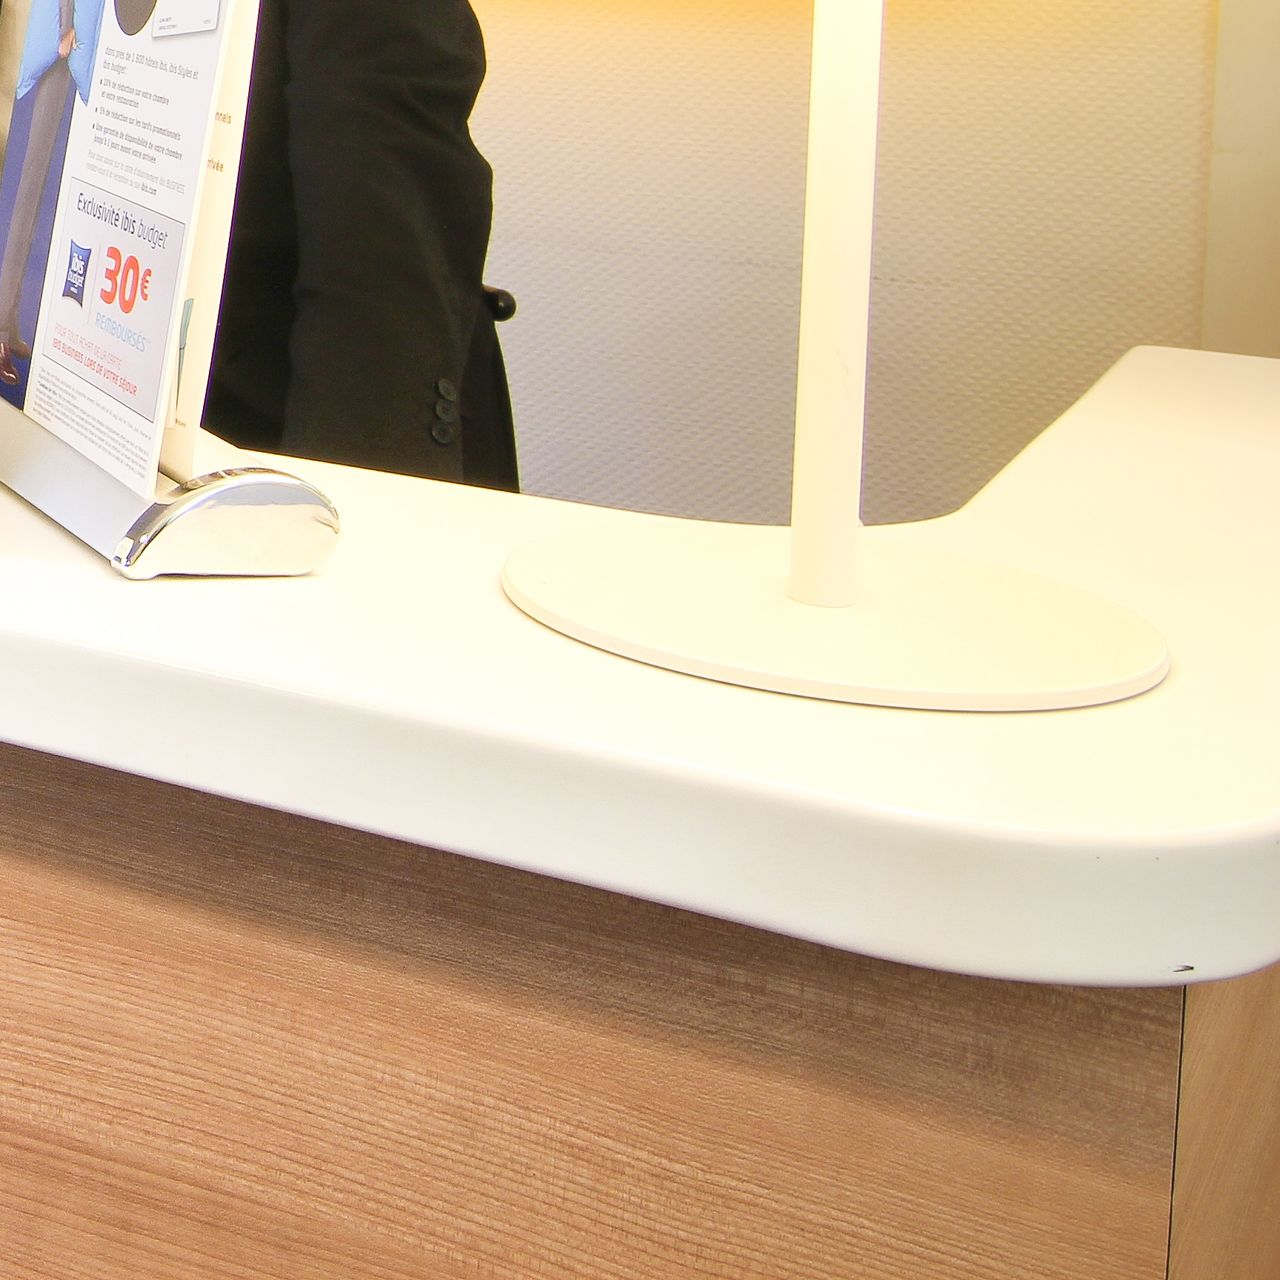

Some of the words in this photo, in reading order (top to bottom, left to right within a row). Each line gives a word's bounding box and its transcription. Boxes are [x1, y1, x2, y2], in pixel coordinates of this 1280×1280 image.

[105, 46, 115, 56] dans
[77, 192, 120, 227] Exclusivité
[120, 209, 136, 236] ibis
[136, 216, 169, 250] budget
[71, 251, 85, 274] ibis
[99, 246, 152, 314] 30€
[95, 312, 146, 353] REMBOURSÉS
[52, 337, 62, 350] IBIS
[62, 342, 84, 364] BUSINESS
[84, 353, 96, 371] LORS
[96, 361, 103, 375] DE
[103, 365, 119, 386] VOTRE
[119, 373, 138, 396] SÉJOUR
